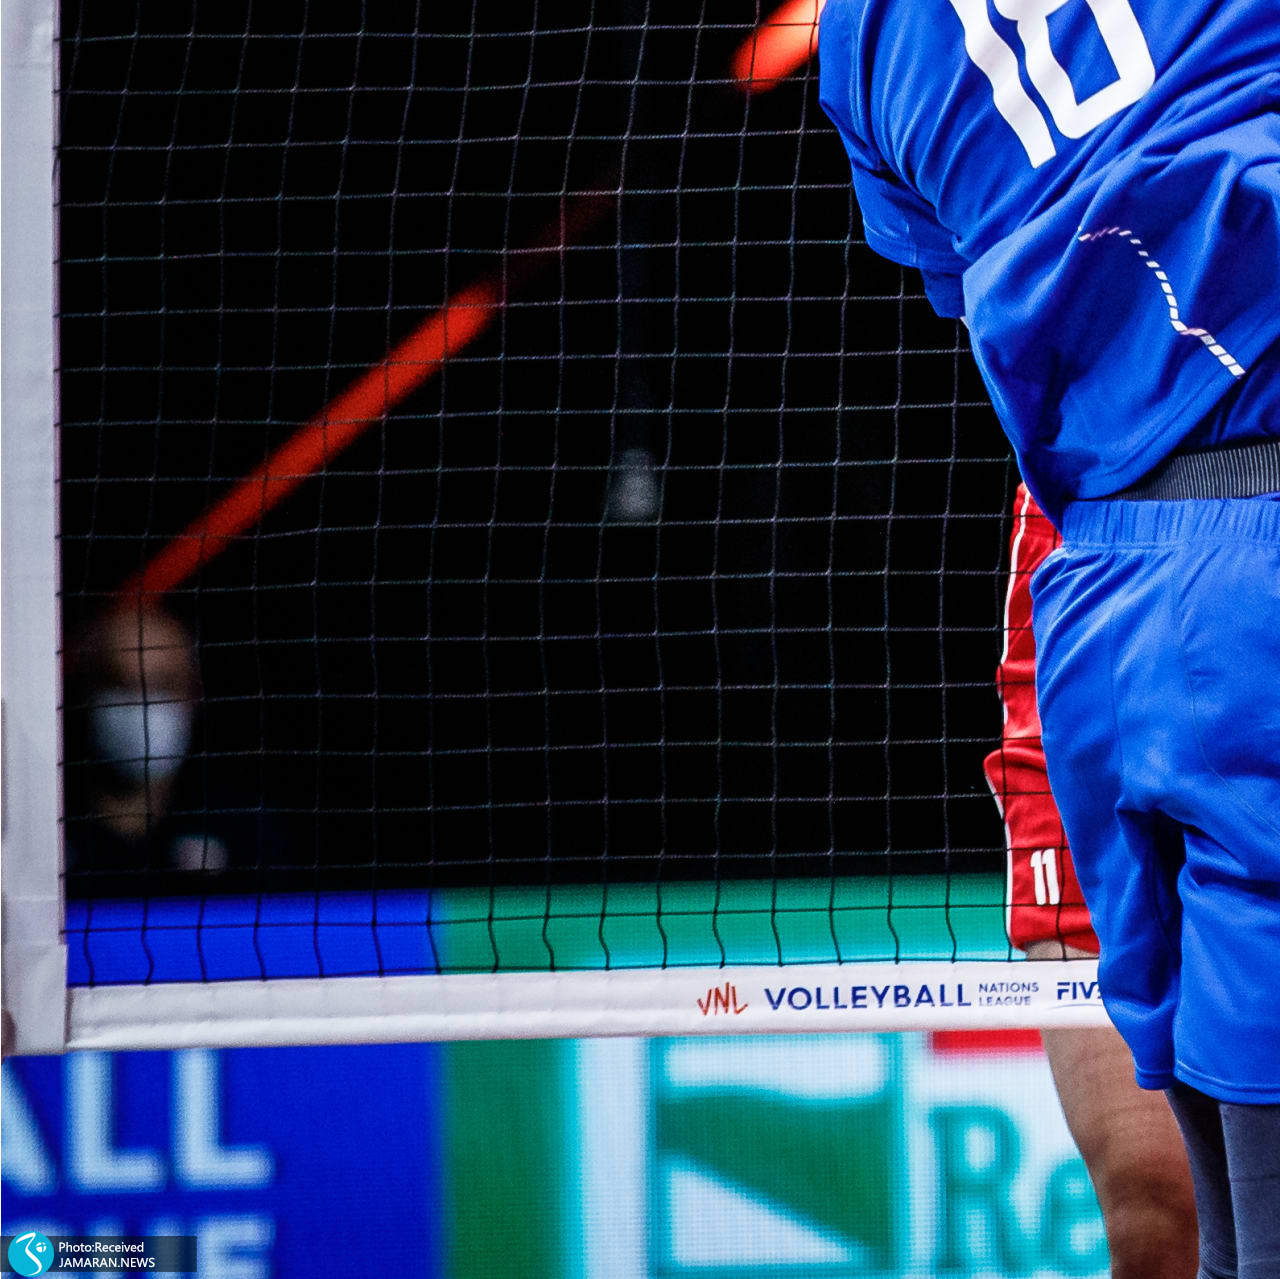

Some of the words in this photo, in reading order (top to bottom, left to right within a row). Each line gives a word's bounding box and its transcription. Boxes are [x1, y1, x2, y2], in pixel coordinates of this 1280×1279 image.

[1030, 847, 1061, 907] 11
[978, 981, 1040, 994] NATIONS
[1056, 980, 1101, 1001] FIV
[697, 981, 749, 1017] VNL
[764, 983, 972, 1011] VOLLEYBALL
[978, 995, 1033, 1007] LEAGUE
